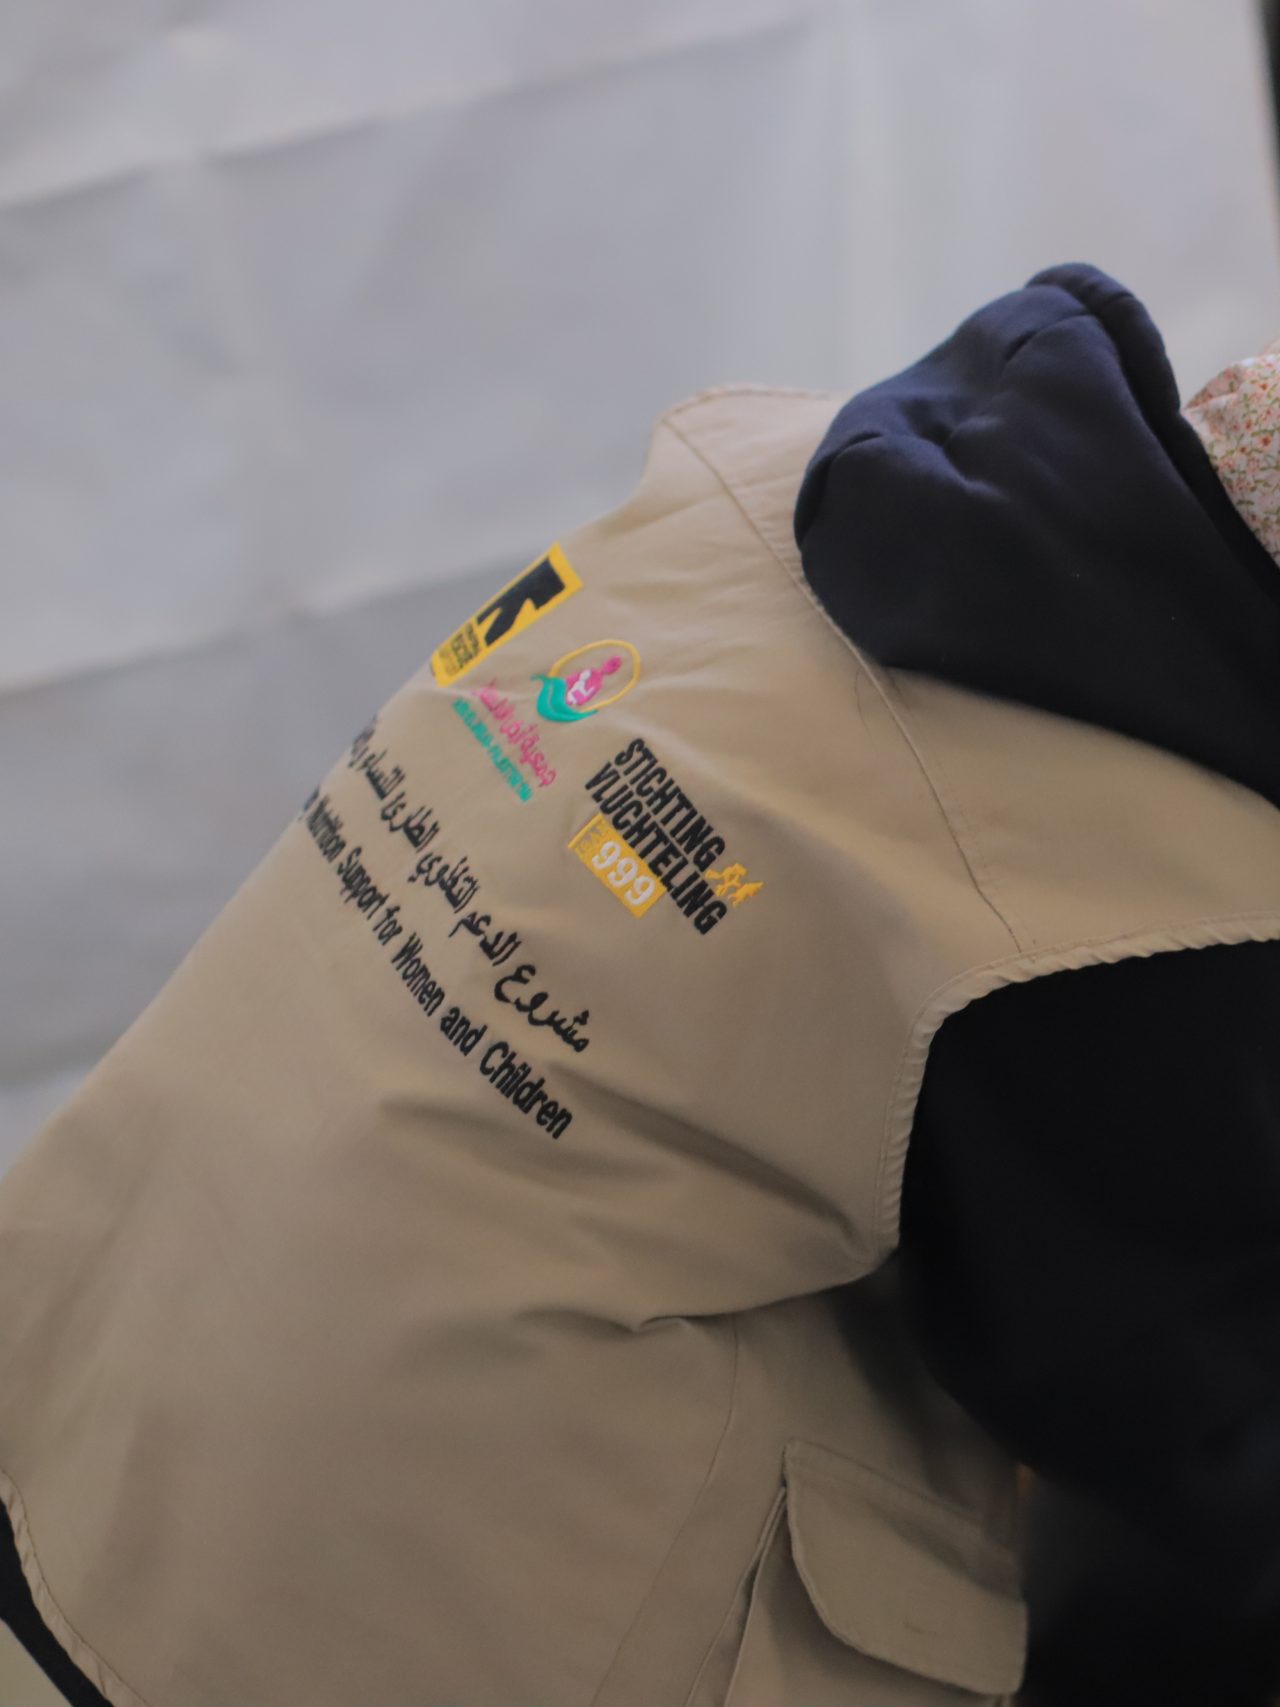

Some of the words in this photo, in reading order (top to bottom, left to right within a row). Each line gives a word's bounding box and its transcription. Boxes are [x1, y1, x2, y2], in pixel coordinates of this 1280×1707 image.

[585, 762, 727, 935] VLUCHTELING
[615, 738, 725, 872] STICHTING
[592, 841, 655, 905] 999
[336, 847, 391, 921] Support
[372, 904, 404, 947] for
[391, 931, 446, 1018] Women
[440, 1006, 488, 1057] and
[479, 1040, 573, 1140] Children
[448, 911, 522, 968] الدعم
[494, 964, 590, 1053] مشروع
